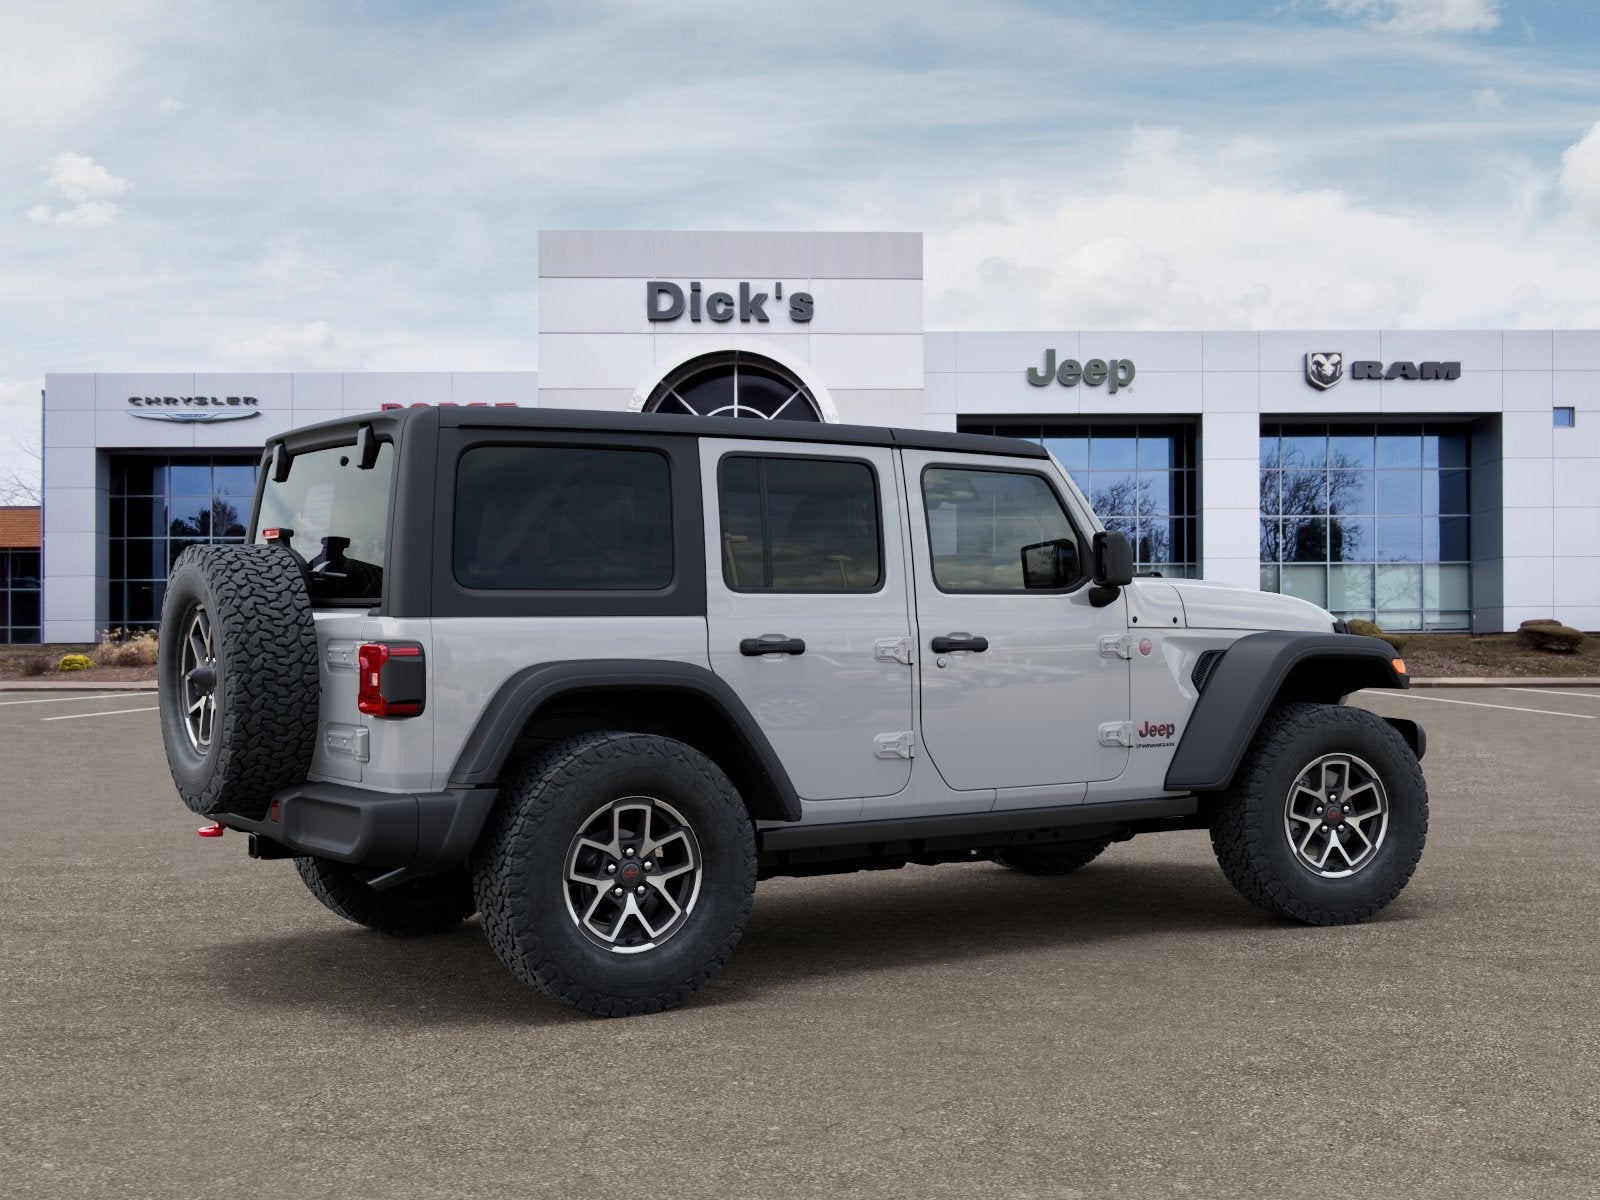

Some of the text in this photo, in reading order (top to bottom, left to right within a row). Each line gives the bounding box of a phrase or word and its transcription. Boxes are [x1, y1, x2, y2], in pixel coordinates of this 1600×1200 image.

[647, 281, 814, 322] Dick's
[1027, 349, 1135, 394] Jeep
[1352, 361, 1461, 380] RAM
[128, 396, 258, 407] CHRYSLER
[1138, 720, 1175, 739] Jeep
